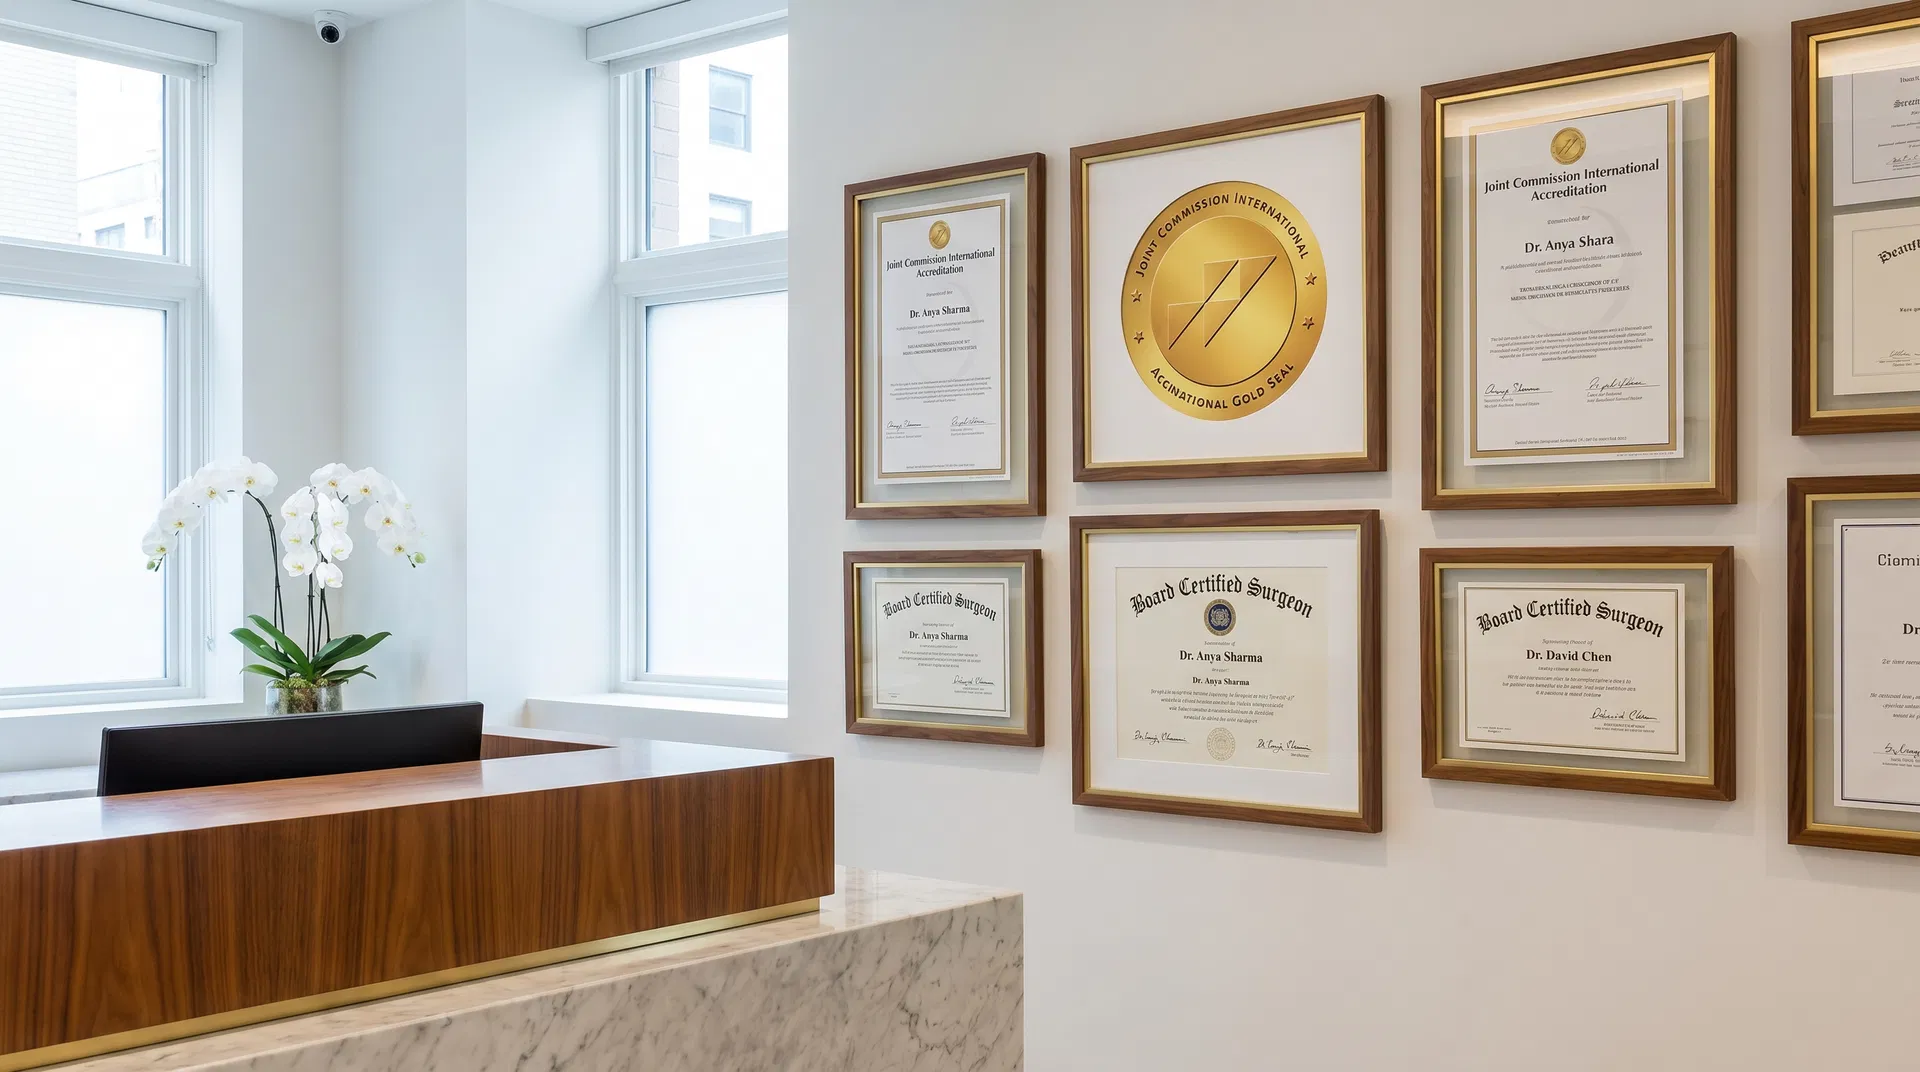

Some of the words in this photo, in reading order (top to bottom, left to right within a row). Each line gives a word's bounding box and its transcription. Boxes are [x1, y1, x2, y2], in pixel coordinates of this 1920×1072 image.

[1484, 179, 1510, 194] Joint
[1513, 171, 1580, 189] Commission
[1584, 158, 1659, 180] International
[1531, 184, 1607, 201] Accreditation
[1525, 242, 1542, 253] Dr.
[1545, 240, 1575, 253] Anya
[1579, 235, 1614, 248] Shara
[886, 260, 903, 272] Joint
[904, 254, 947, 268] Commission
[948, 247, 995, 262] International
[916, 264, 964, 278] Accreditation
[909, 309, 920, 319] Dr.
[922, 307, 940, 318] Anya
[941, 304, 970, 315] Sharma
[1129, 582, 1175, 618] Board
[1178, 574, 1242, 596] Certified
[1246, 577, 1313, 618] Surgeon
[882, 595, 912, 619] Board
[913, 590, 953, 607] Certified
[954, 592, 997, 621] Surgeon
[1476, 604, 1523, 635] Board
[1526, 597, 1591, 618] Certified
[1595, 600, 1664, 637] Surgeon
[909, 631, 920, 639] Dr.
[921, 632, 939, 642] Anya
[940, 632, 969, 641] Sharma
[1179, 650, 1194, 660] Dr.
[1197, 651, 1221, 664] Anya
[1223, 651, 1263, 663] Sharma
[1526, 649, 1543, 660] Dr.
[1546, 650, 1579, 661] David
[1582, 651, 1612, 662] Chen
[1204, 677, 1222, 686] Anya
[1223, 678, 1250, 686] Sharma
